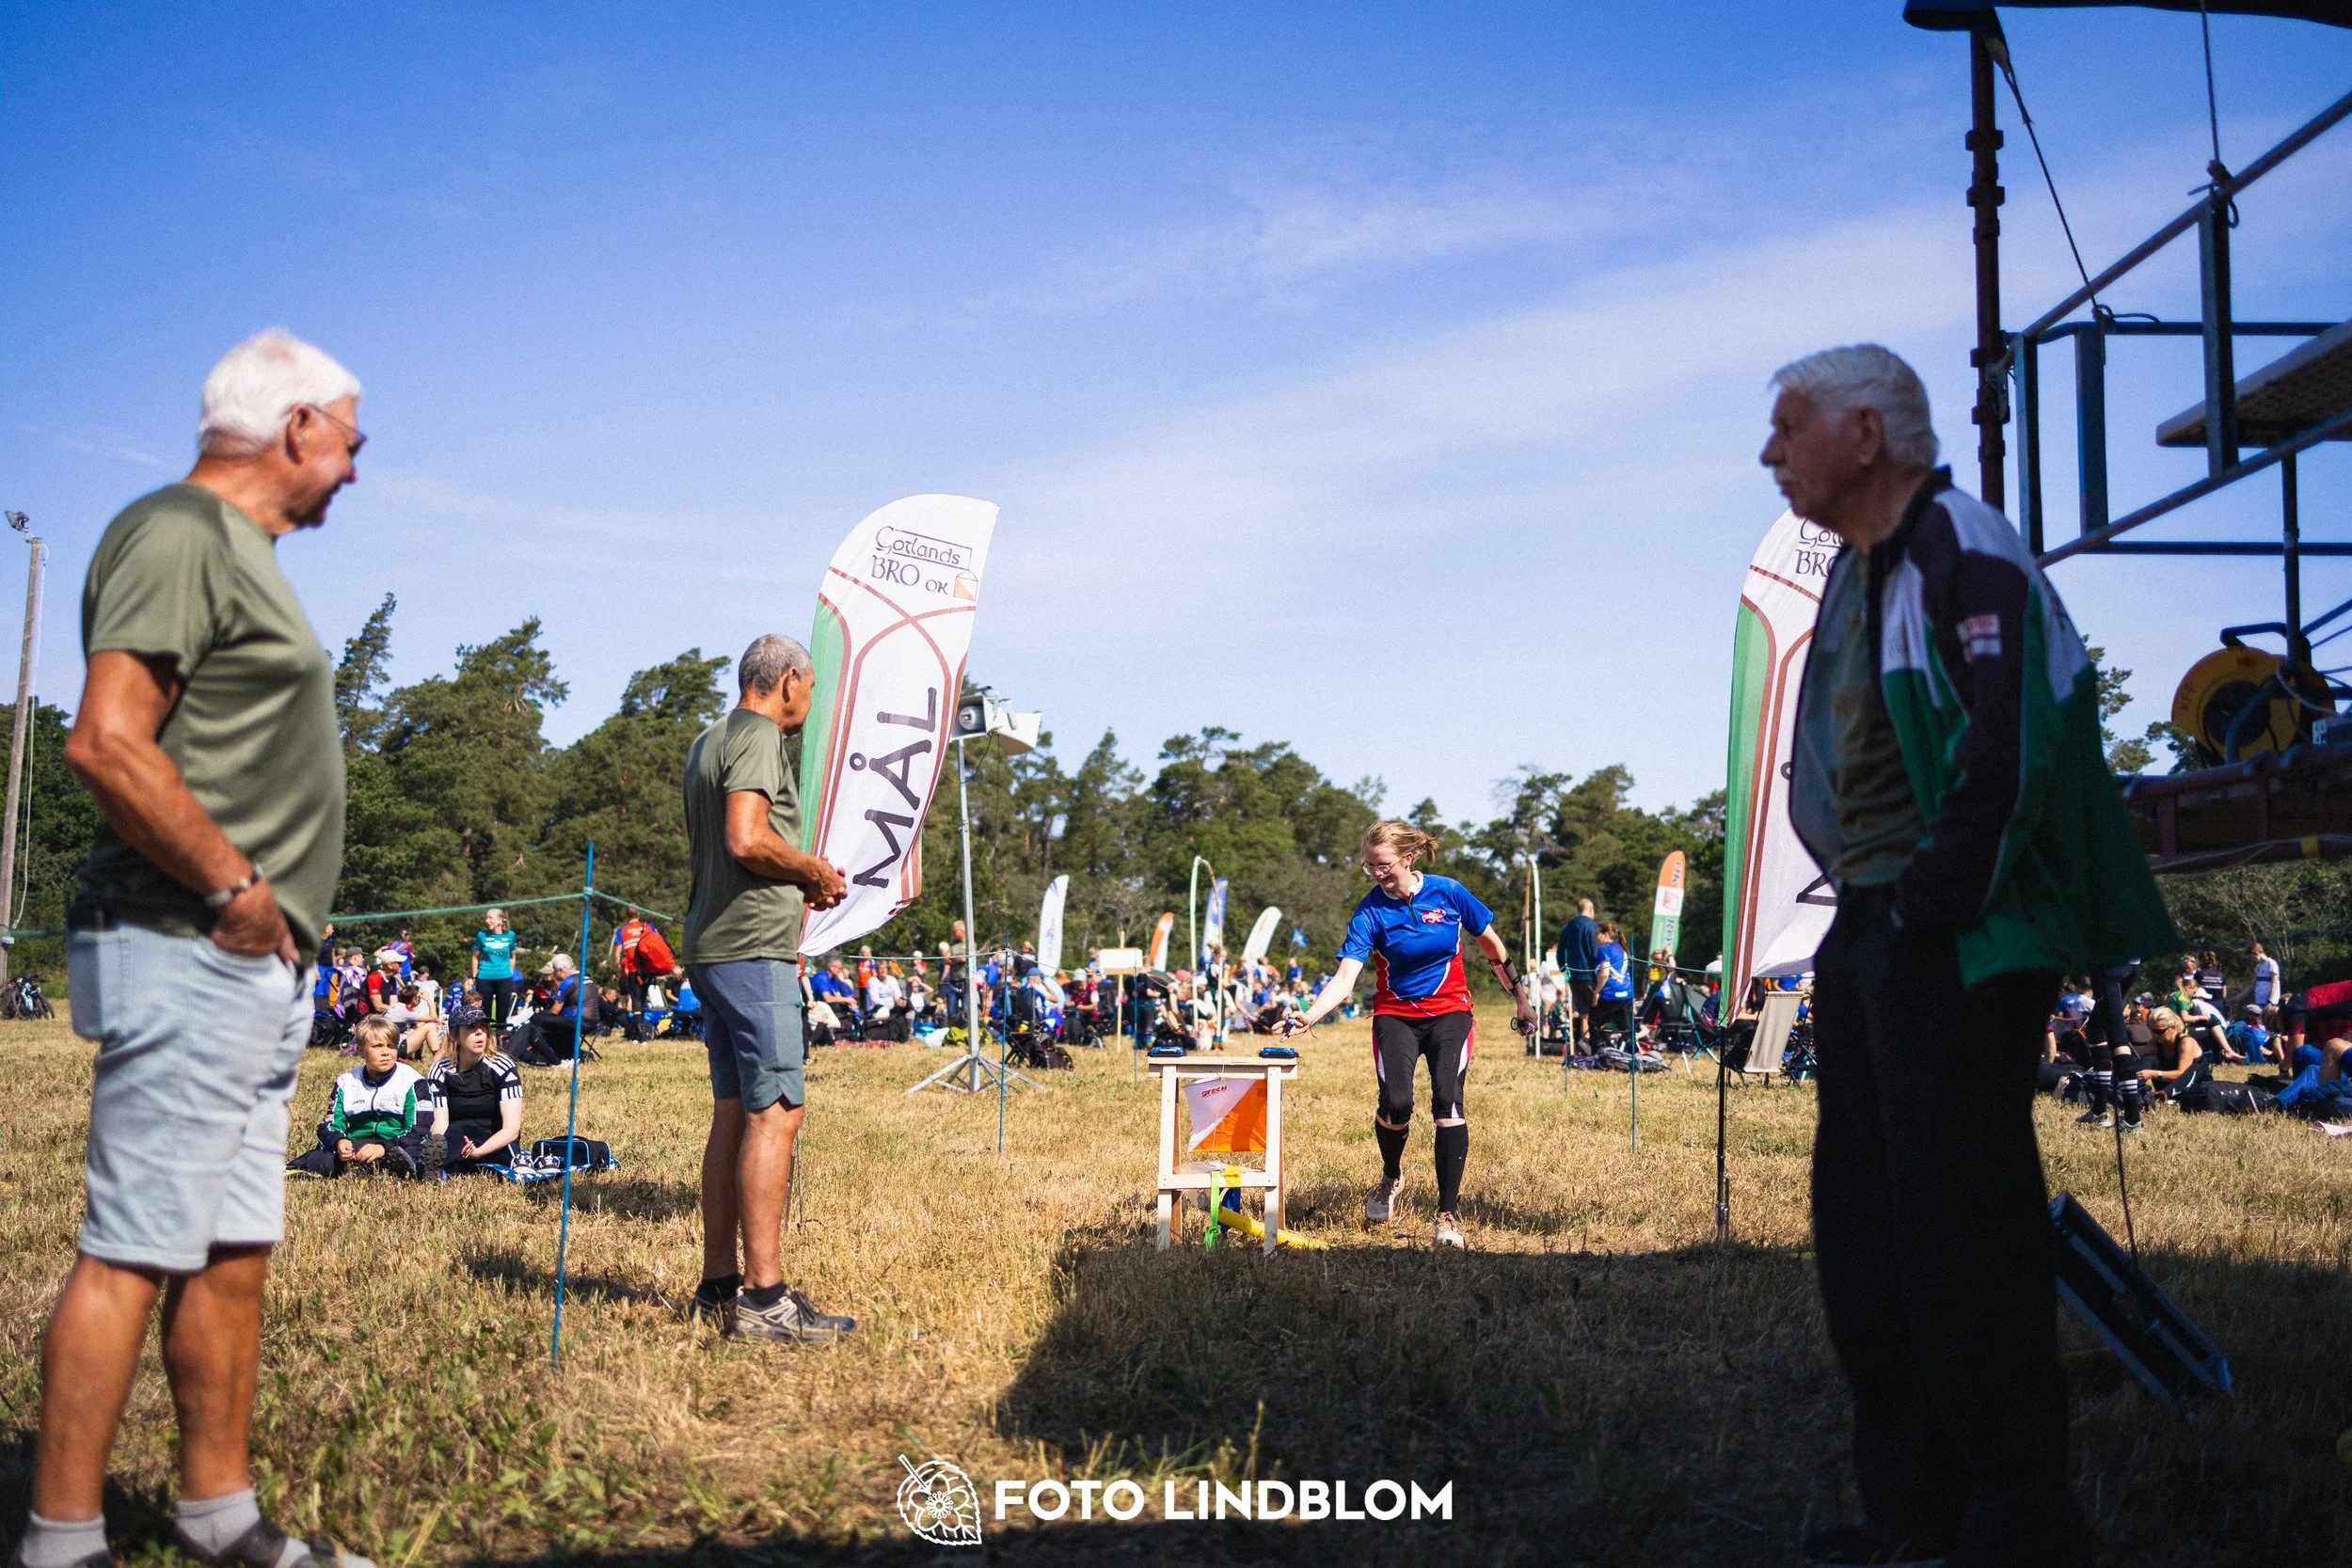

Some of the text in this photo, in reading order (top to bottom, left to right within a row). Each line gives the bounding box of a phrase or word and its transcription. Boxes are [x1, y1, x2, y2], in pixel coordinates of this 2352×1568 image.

[875, 525, 961, 565] Gotlands
[871, 554, 948, 595] BRO OK
[849, 687, 937, 889] MÅL
